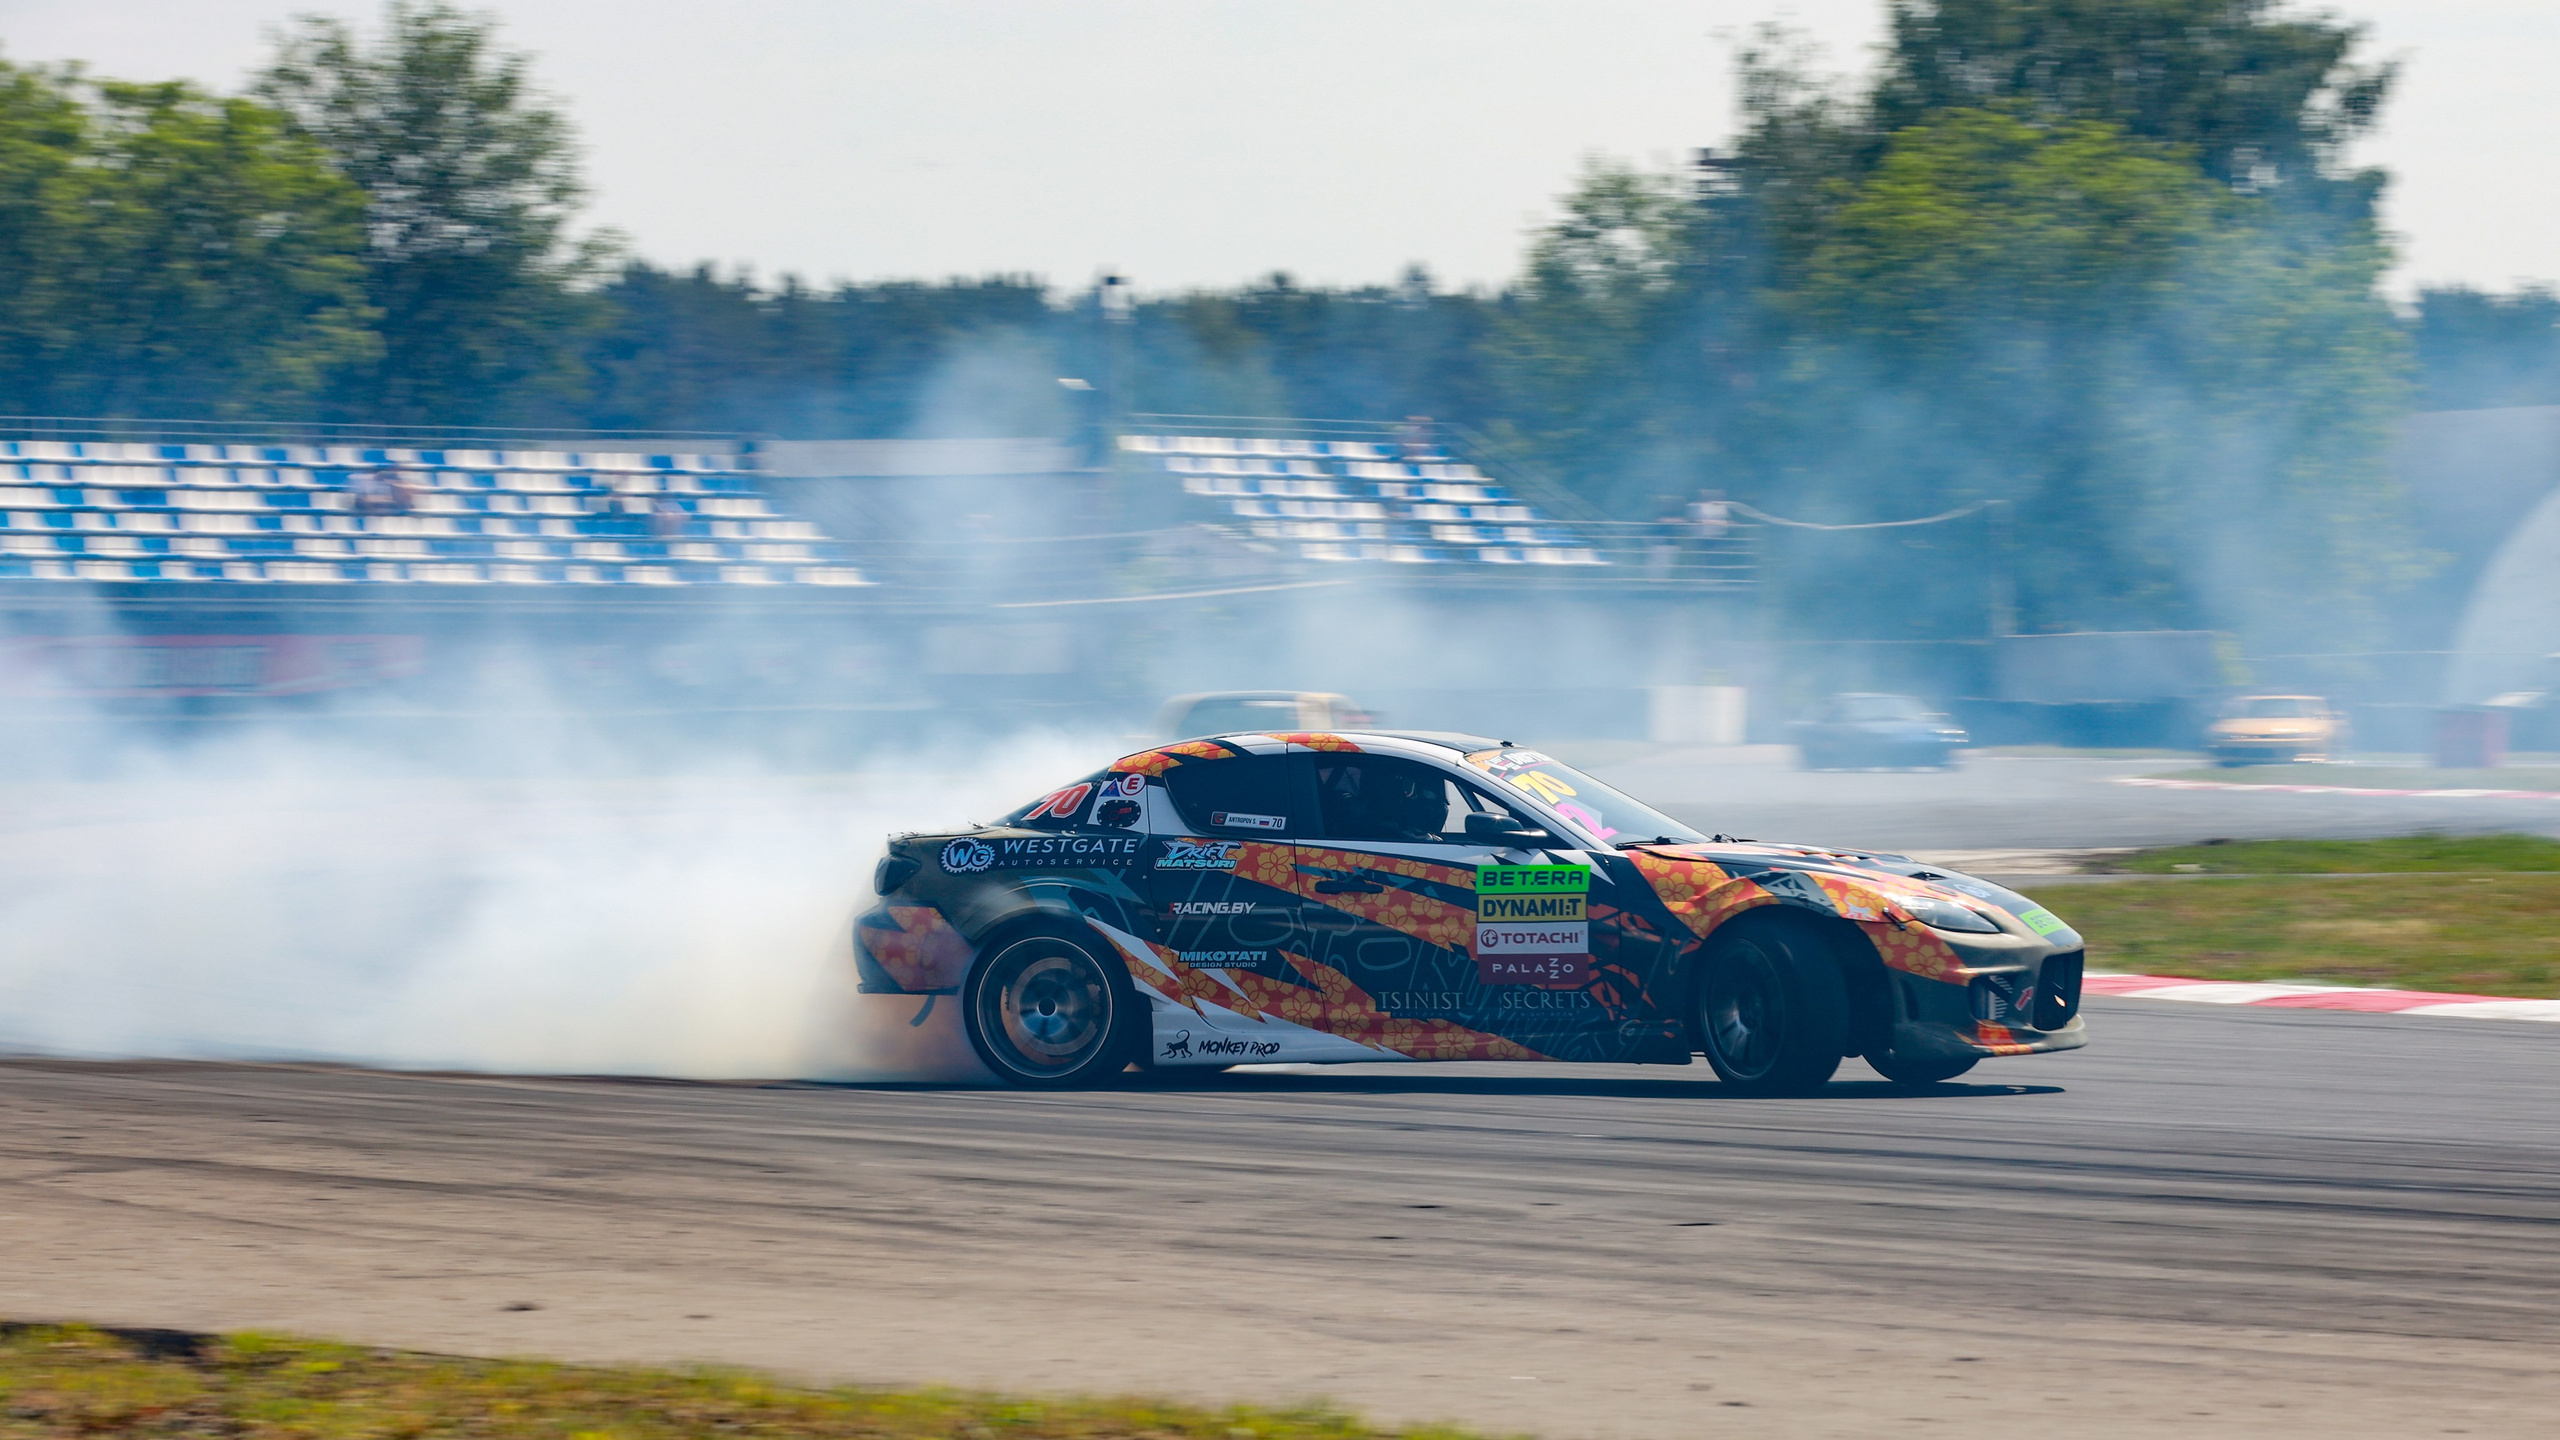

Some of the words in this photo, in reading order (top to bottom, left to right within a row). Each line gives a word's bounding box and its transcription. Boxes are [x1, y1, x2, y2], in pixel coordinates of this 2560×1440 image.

[1126, 777, 1141, 790] E
[1508, 770, 1577, 805] 70
[1020, 782, 1093, 821] 70
[1228, 816, 1253, 825] ANTROPOV
[1271, 817, 1283, 828] 70
[1003, 838, 1138, 855] WESTGATE
[1165, 840, 1241, 860] DRIFT
[998, 858, 1133, 867] AUTOSERVICE
[1156, 859, 1236, 868] MATSURI
[1482, 870, 1584, 887] BET.ERA
[1500, 931, 1579, 945] TOTACHI
[1179, 950, 1268, 962] MIKOTATI
[1378, 991, 1464, 1010] TSINIST
[1502, 991, 1591, 1010] SECRETS
[1198, 1036, 1249, 1056] MONKEY
[1249, 1041, 1281, 1058] PROD
